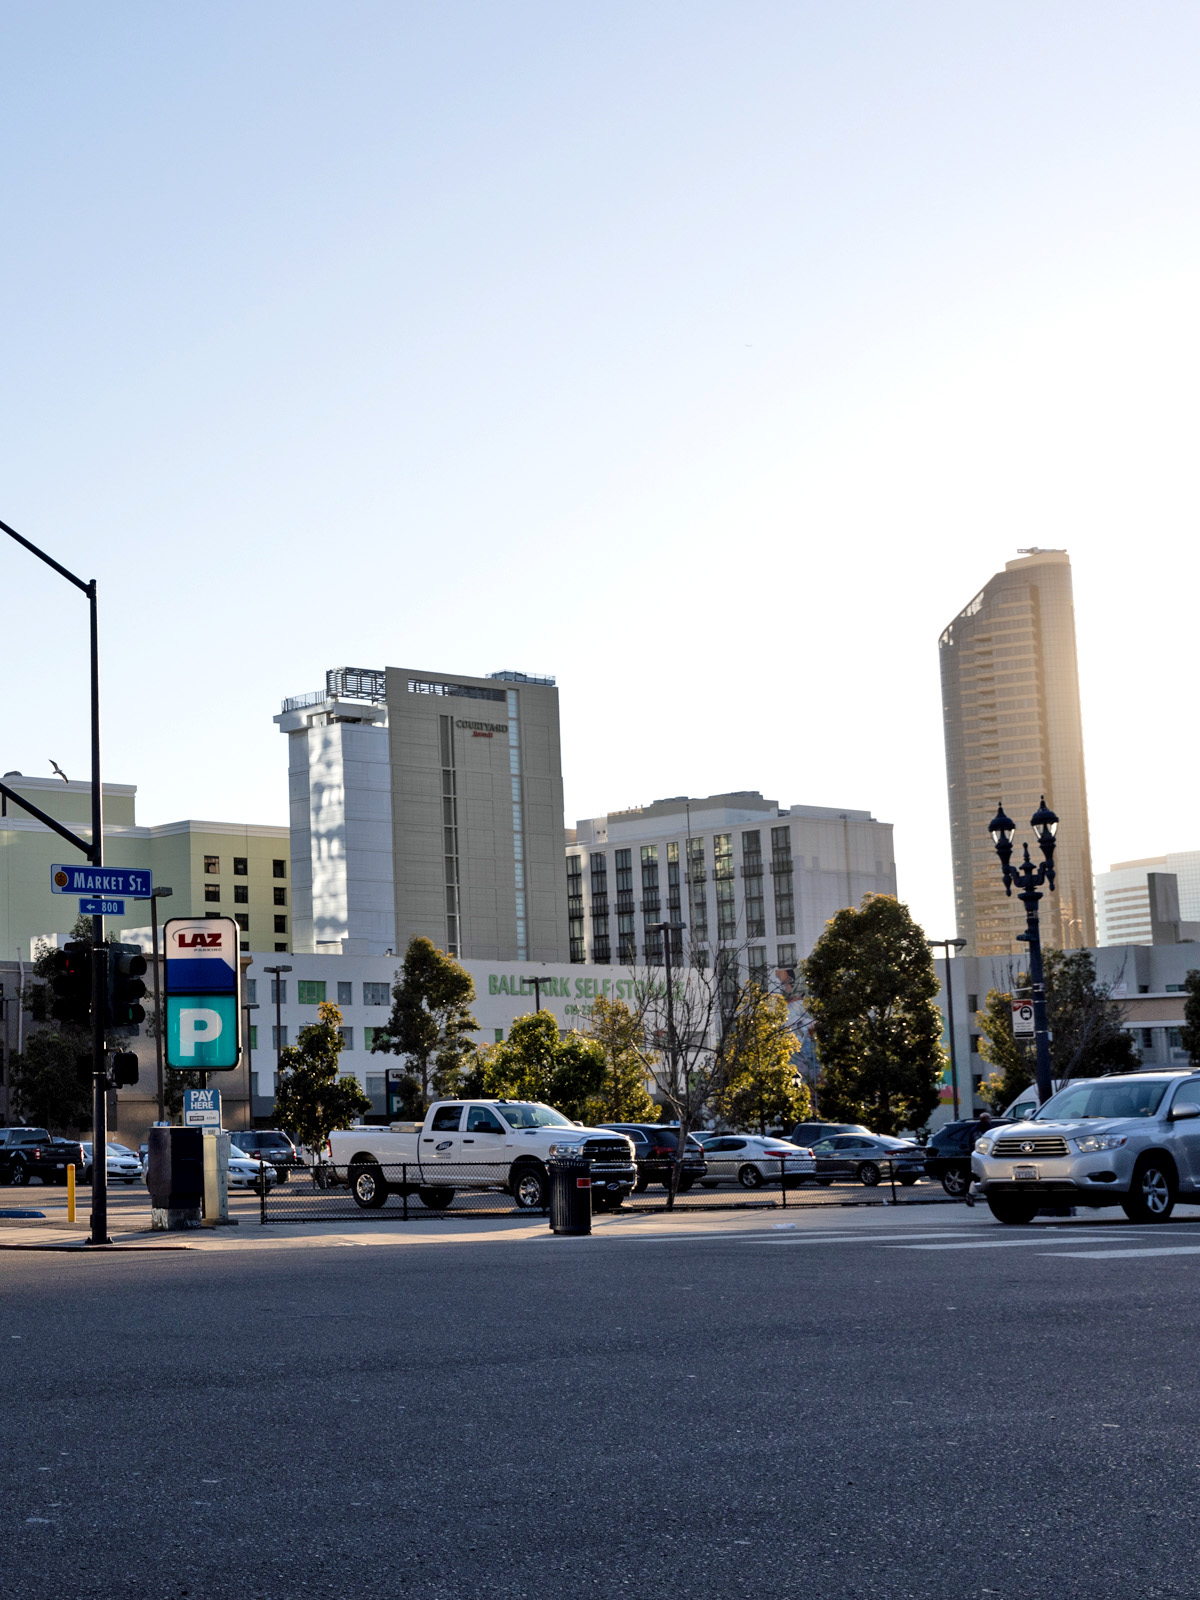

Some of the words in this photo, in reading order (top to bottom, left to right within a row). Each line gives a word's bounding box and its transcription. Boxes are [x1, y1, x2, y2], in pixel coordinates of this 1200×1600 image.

[456, 719, 509, 733] COURTYARD
[101, 902, 118, 913] 800
[178, 933, 222, 948] LAZ
[574, 977, 611, 999] SELF
[179, 1008, 223, 1057] P
[190, 1090, 214, 1102] PAY
[190, 1101, 214, 1110] HERE
